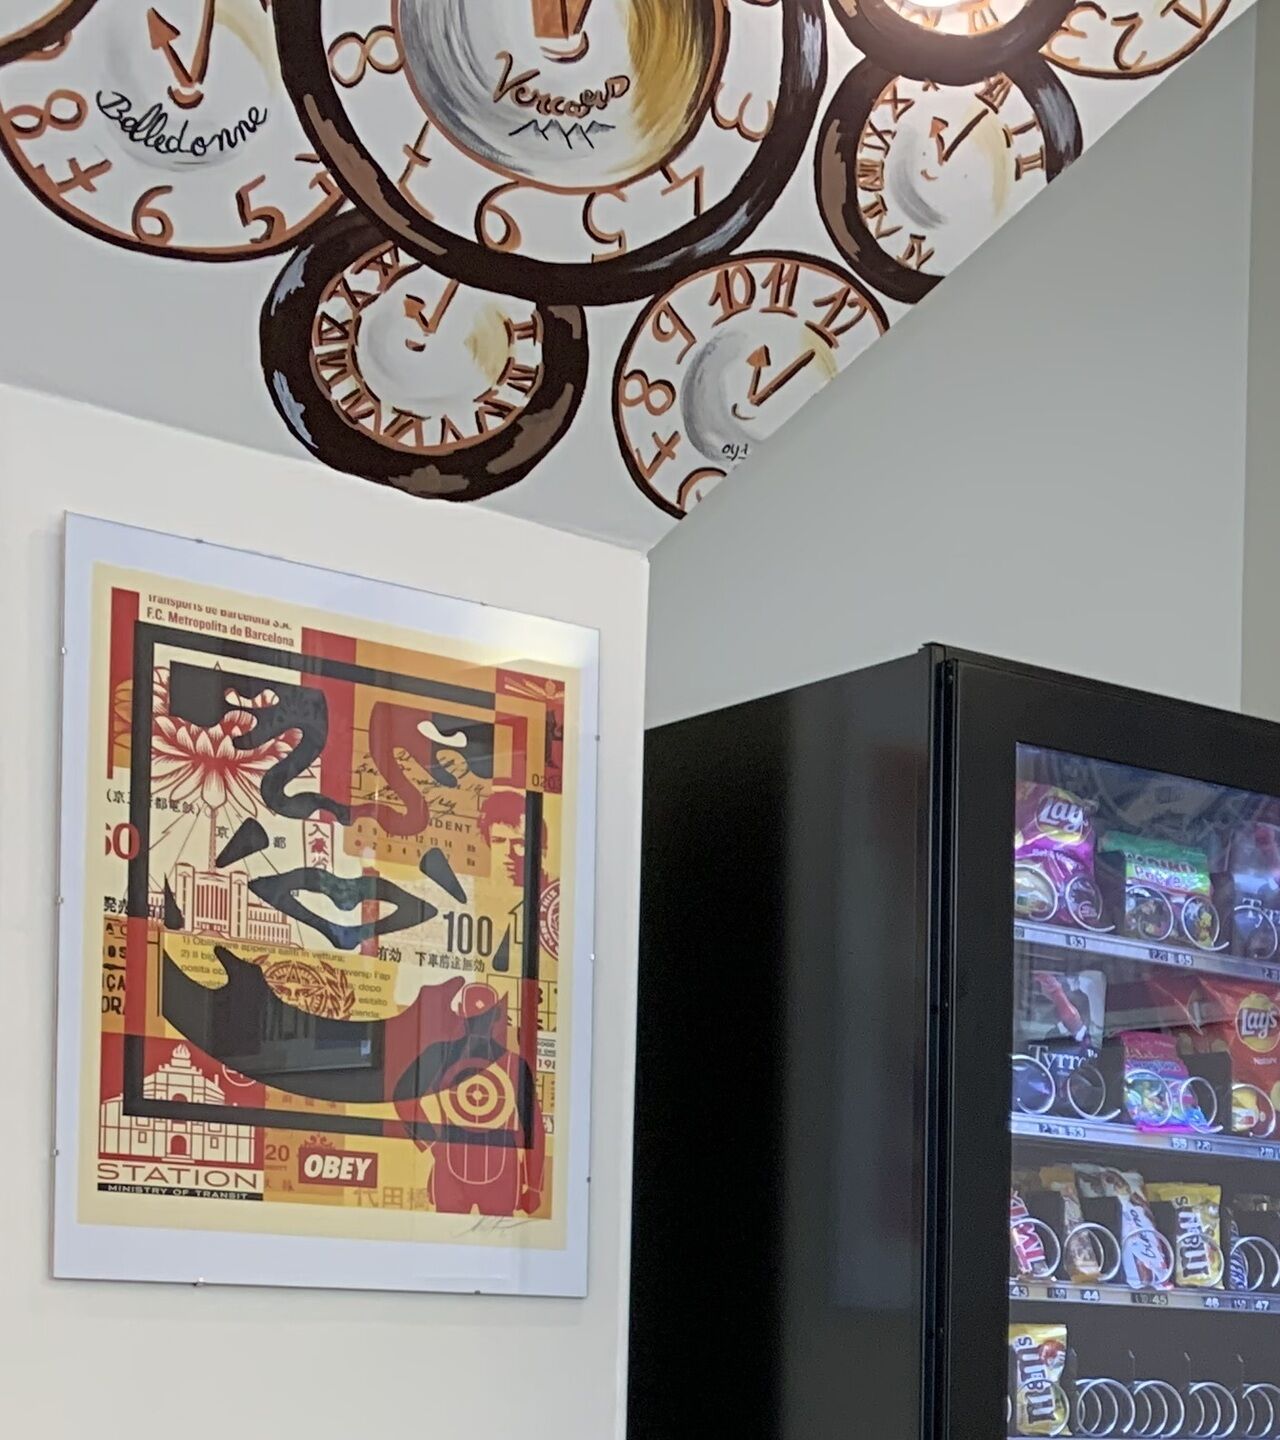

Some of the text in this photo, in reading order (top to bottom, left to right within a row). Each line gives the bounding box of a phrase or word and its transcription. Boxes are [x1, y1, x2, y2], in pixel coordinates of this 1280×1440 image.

[132, 185, 174, 245] 6
[236, 175, 286, 244] 5
[652, 301, 697, 365] 9
[621, 369, 677, 416] 8
[146, 606, 295, 647] F.C. Metropolita de Barcelona
[443, 911, 493, 957] 100
[1241, 1008, 1277, 1038] Lay's
[265, 1144, 289, 1162] 20
[304, 1154, 372, 1181] OBEY
[97, 1163, 257, 1189] STATION
[108, 1184, 249, 1200] MINISTRY OF TRANSIT
[1011, 1286, 1028, 1297] 43
[1084, 1291, 1099, 1300] 44
[1153, 1295, 1167, 1305] 45
[1256, 1301, 1269, 1309] 47
